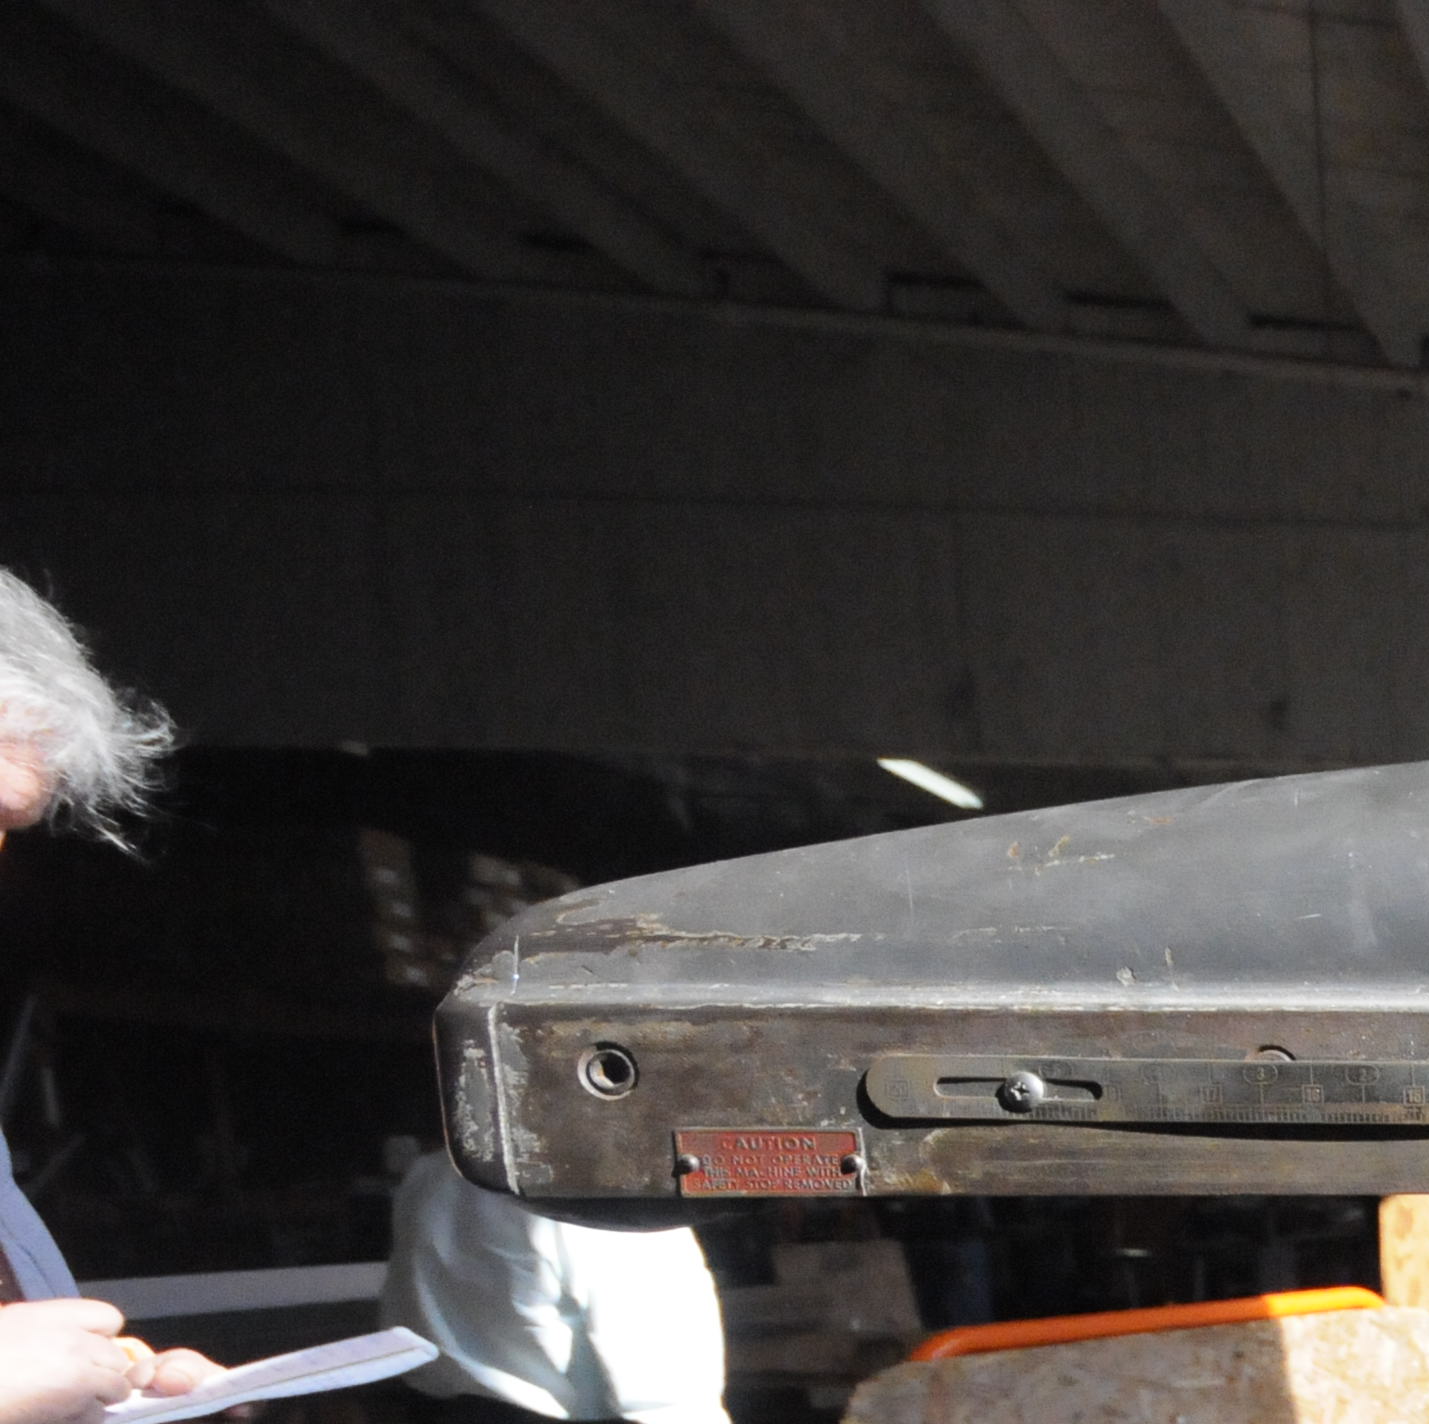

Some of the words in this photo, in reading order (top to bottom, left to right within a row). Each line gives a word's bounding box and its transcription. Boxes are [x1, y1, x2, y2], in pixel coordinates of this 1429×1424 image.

[722, 1135, 816, 1150] CAUTION
[733, 1154, 763, 1166] NOT
[771, 1154, 841, 1166] OPERATE
[806, 1167, 841, 1178] WITH
[784, 1179, 852, 1191] REMOVED
